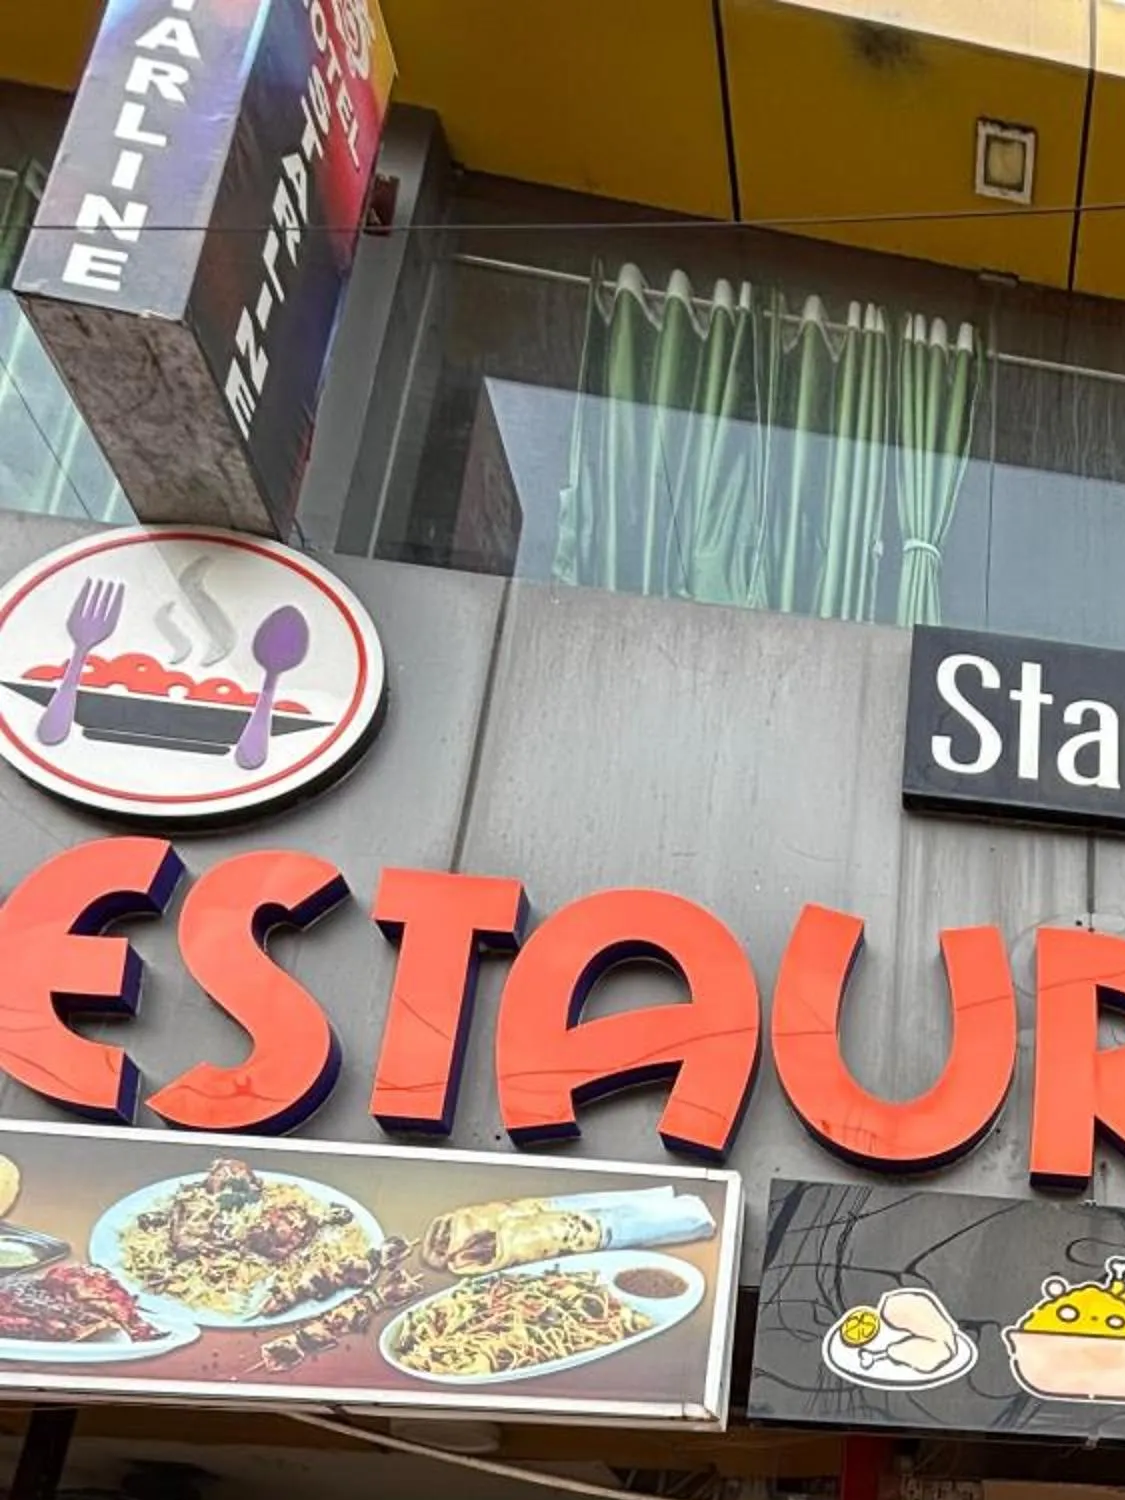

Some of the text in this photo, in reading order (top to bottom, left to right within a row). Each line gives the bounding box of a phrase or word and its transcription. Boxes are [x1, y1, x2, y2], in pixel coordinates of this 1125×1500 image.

[62, 0, 201, 292] ARLINE
[303, 0, 360, 168] OTEL
[225, 65, 330, 440] STARLINE
